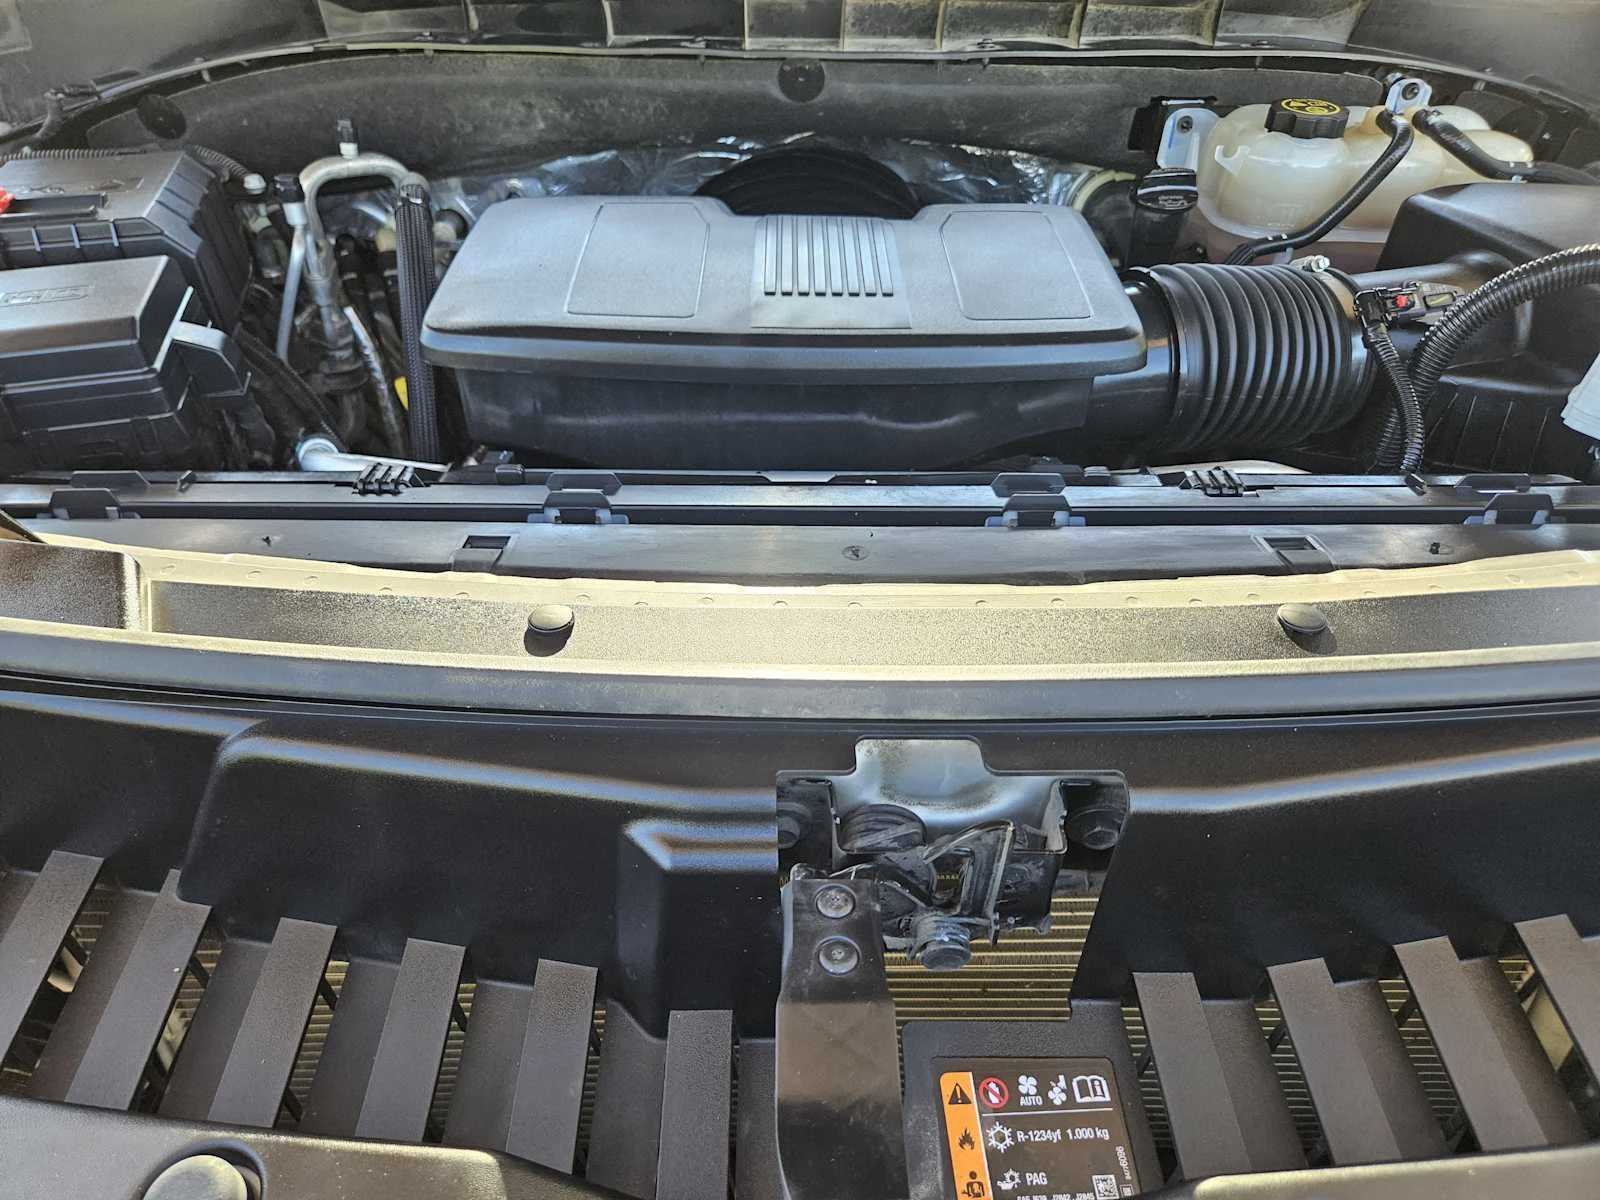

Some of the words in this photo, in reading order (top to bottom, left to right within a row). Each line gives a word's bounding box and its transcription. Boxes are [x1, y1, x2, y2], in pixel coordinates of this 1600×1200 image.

[1020, 1095, 1043, 1106] AUTO
[1016, 1128, 1062, 1143] R-1234yf
[1066, 1127, 1095, 1140] 1.000
[1095, 1127, 1110, 1141] kg
[1025, 1172, 1048, 1186] PAG
